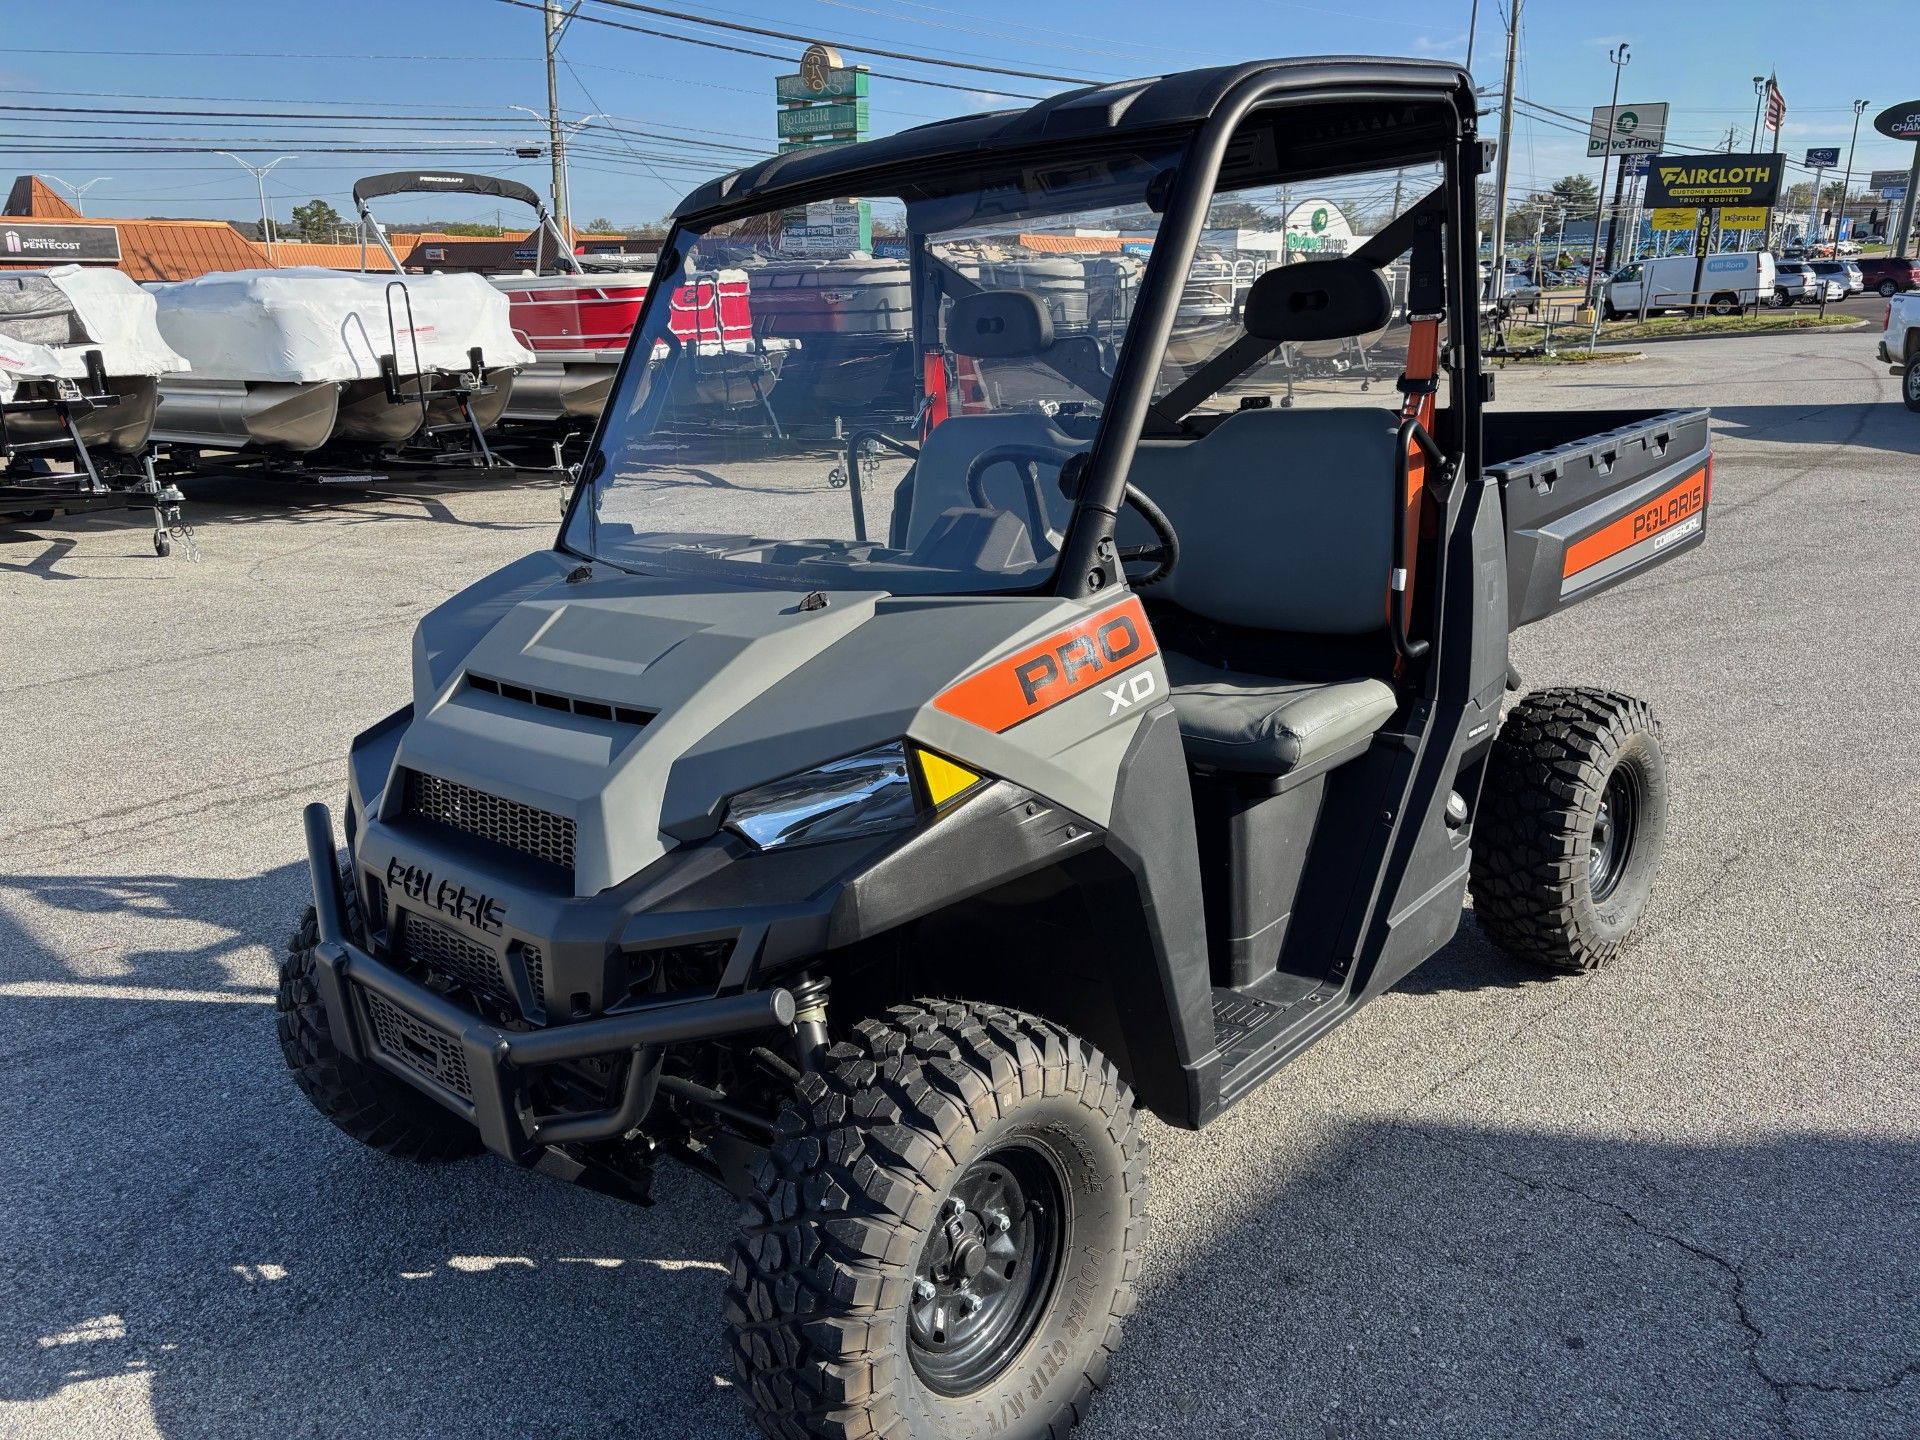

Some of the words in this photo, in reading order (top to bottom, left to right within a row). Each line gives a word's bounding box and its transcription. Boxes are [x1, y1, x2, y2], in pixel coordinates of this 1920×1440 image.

[781, 108, 829, 128] Rothchild
[800, 124, 831, 132] CONFERENCE
[1590, 138, 1659, 150] DrveTime
[1659, 167, 1770, 187] FAIRCLOTH
[22, 241, 81, 250] PENTECOST
[1286, 232, 1348, 251] DriveTime
[1696, 216, 1710, 257] 8812
[600, 253, 641, 263] Ranger
[1711, 261, 1744, 269] Hill-Rom
[1633, 486, 1701, 539] POLARIS
[1015, 615, 1140, 706] PRO
[1102, 670, 1156, 717] XD
[386, 856, 507, 937] POLARIS
[1062, 1246, 1103, 1339] POWER
